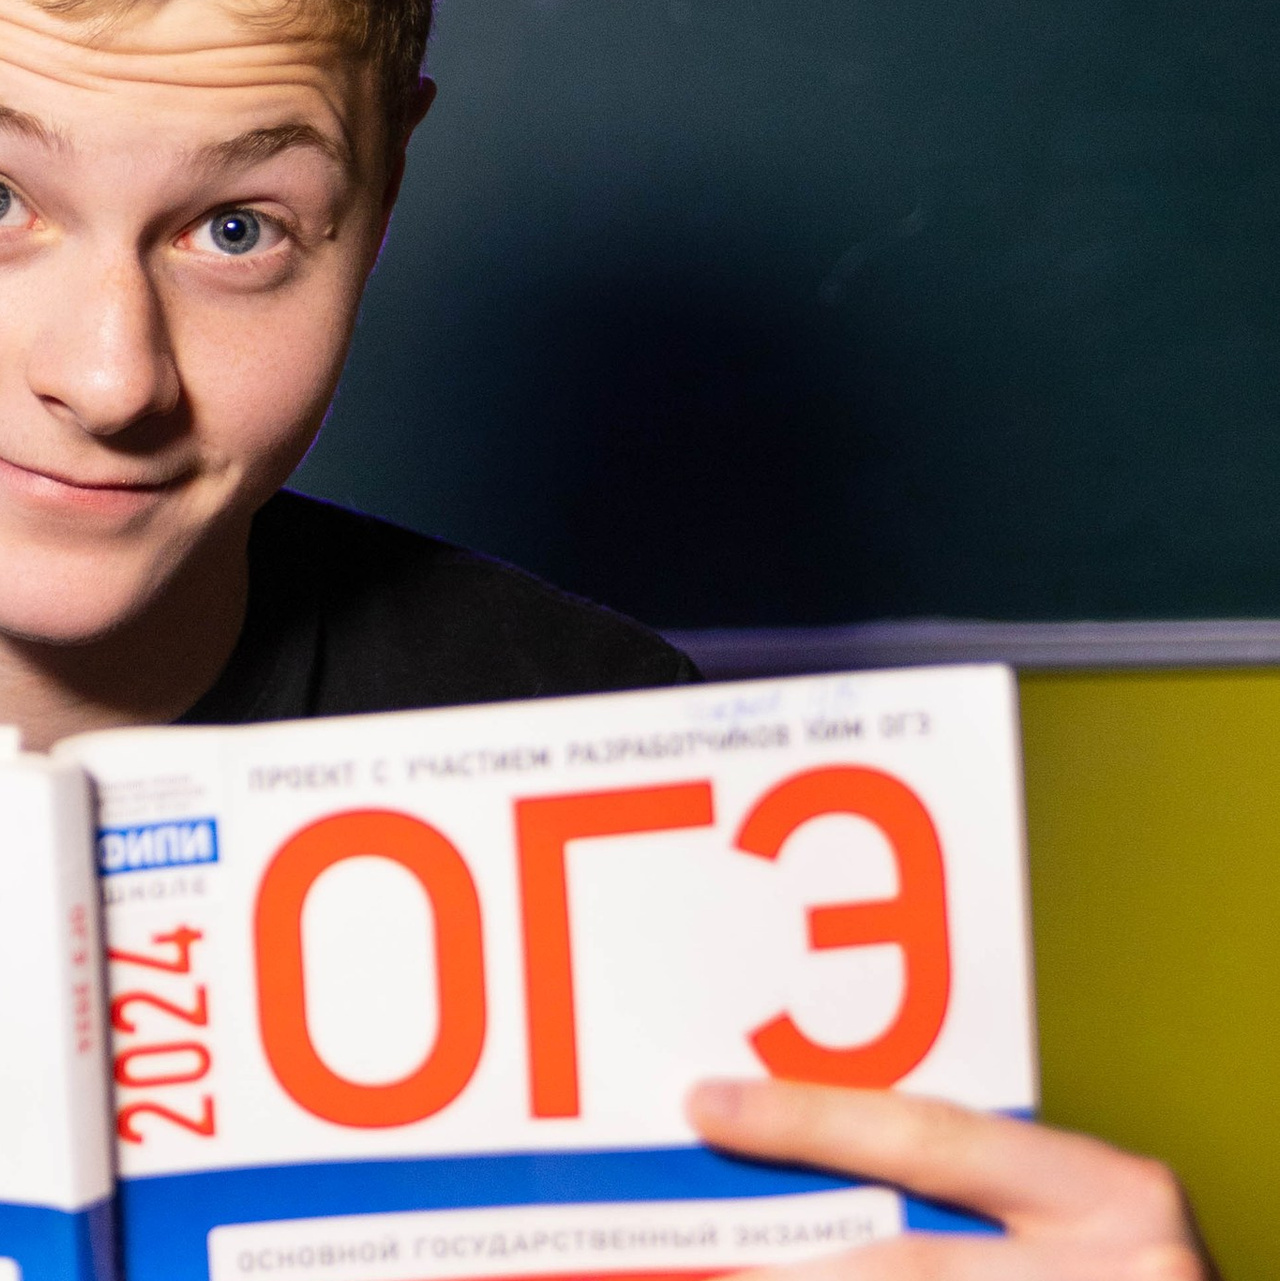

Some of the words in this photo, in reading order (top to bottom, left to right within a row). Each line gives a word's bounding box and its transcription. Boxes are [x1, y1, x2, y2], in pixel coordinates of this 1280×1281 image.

[249, 762, 356, 793] ПРОЕКТ
[406, 745, 551, 784] УЧАСТИЕМ
[252, 762, 953, 1130] ОГЭ
[107, 922, 216, 1144] 2024
[237, 1239, 401, 1274] ОСНОВНОЙ
[412, 1220, 721, 1262] ГОСУДАРСТВЕННЫЙ
[735, 1214, 878, 1250] ЭКЗАМЕН
